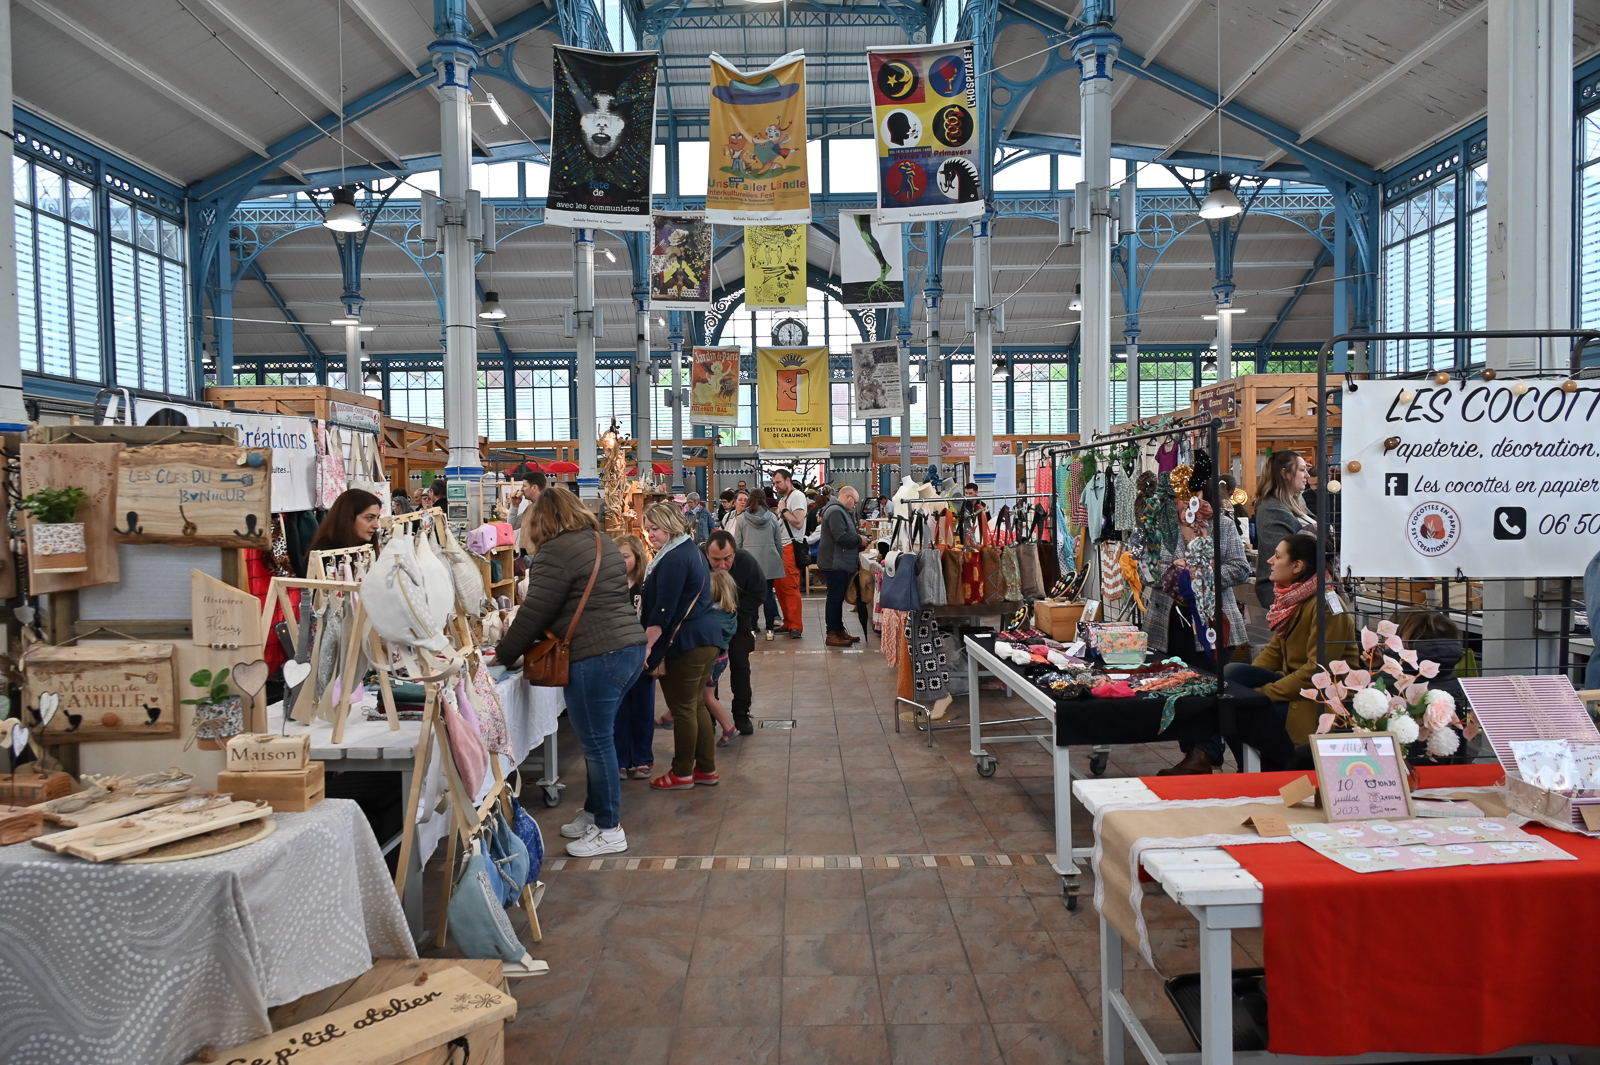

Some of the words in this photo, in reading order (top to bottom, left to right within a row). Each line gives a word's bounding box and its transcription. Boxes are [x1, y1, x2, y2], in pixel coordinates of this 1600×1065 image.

[964, 48, 976, 108] L'HOSPITALET
[708, 178, 739, 189] Unser
[771, 180, 806, 191] Ländle
[592, 188, 604, 196] de
[707, 189, 758, 198] Interkulturelles
[589, 204, 640, 212] communistes
[695, 351, 716, 363] Jardin
[722, 351, 738, 362] Paris
[1386, 388, 1452, 423] LES
[1461, 386, 1600, 423] COCOTT
[128, 470, 150, 483] LES
[156, 469, 188, 484] CLES
[192, 470, 211, 484] DU
[1414, 475, 1440, 493] Les
[1445, 476, 1512, 493] cocottes
[1516, 481, 1536, 493] en
[1538, 478, 1600, 498] papier
[1412, 505, 1439, 525] COCOTTES
[1440, 507, 1449, 515] EN
[1539, 514, 1570, 534] 06
[1574, 513, 1600, 534] 50
[1417, 540, 1448, 552] CREATIONS
[203, 596, 243, 604] Histoires
[58, 681, 120, 693] Maison
[125, 683, 140, 691] de
[231, 746, 296, 762] Maison
[1337, 779, 1354, 792] 10
[1336, 807, 1360, 815] 2023
[353, 991, 442, 1029] atelier
